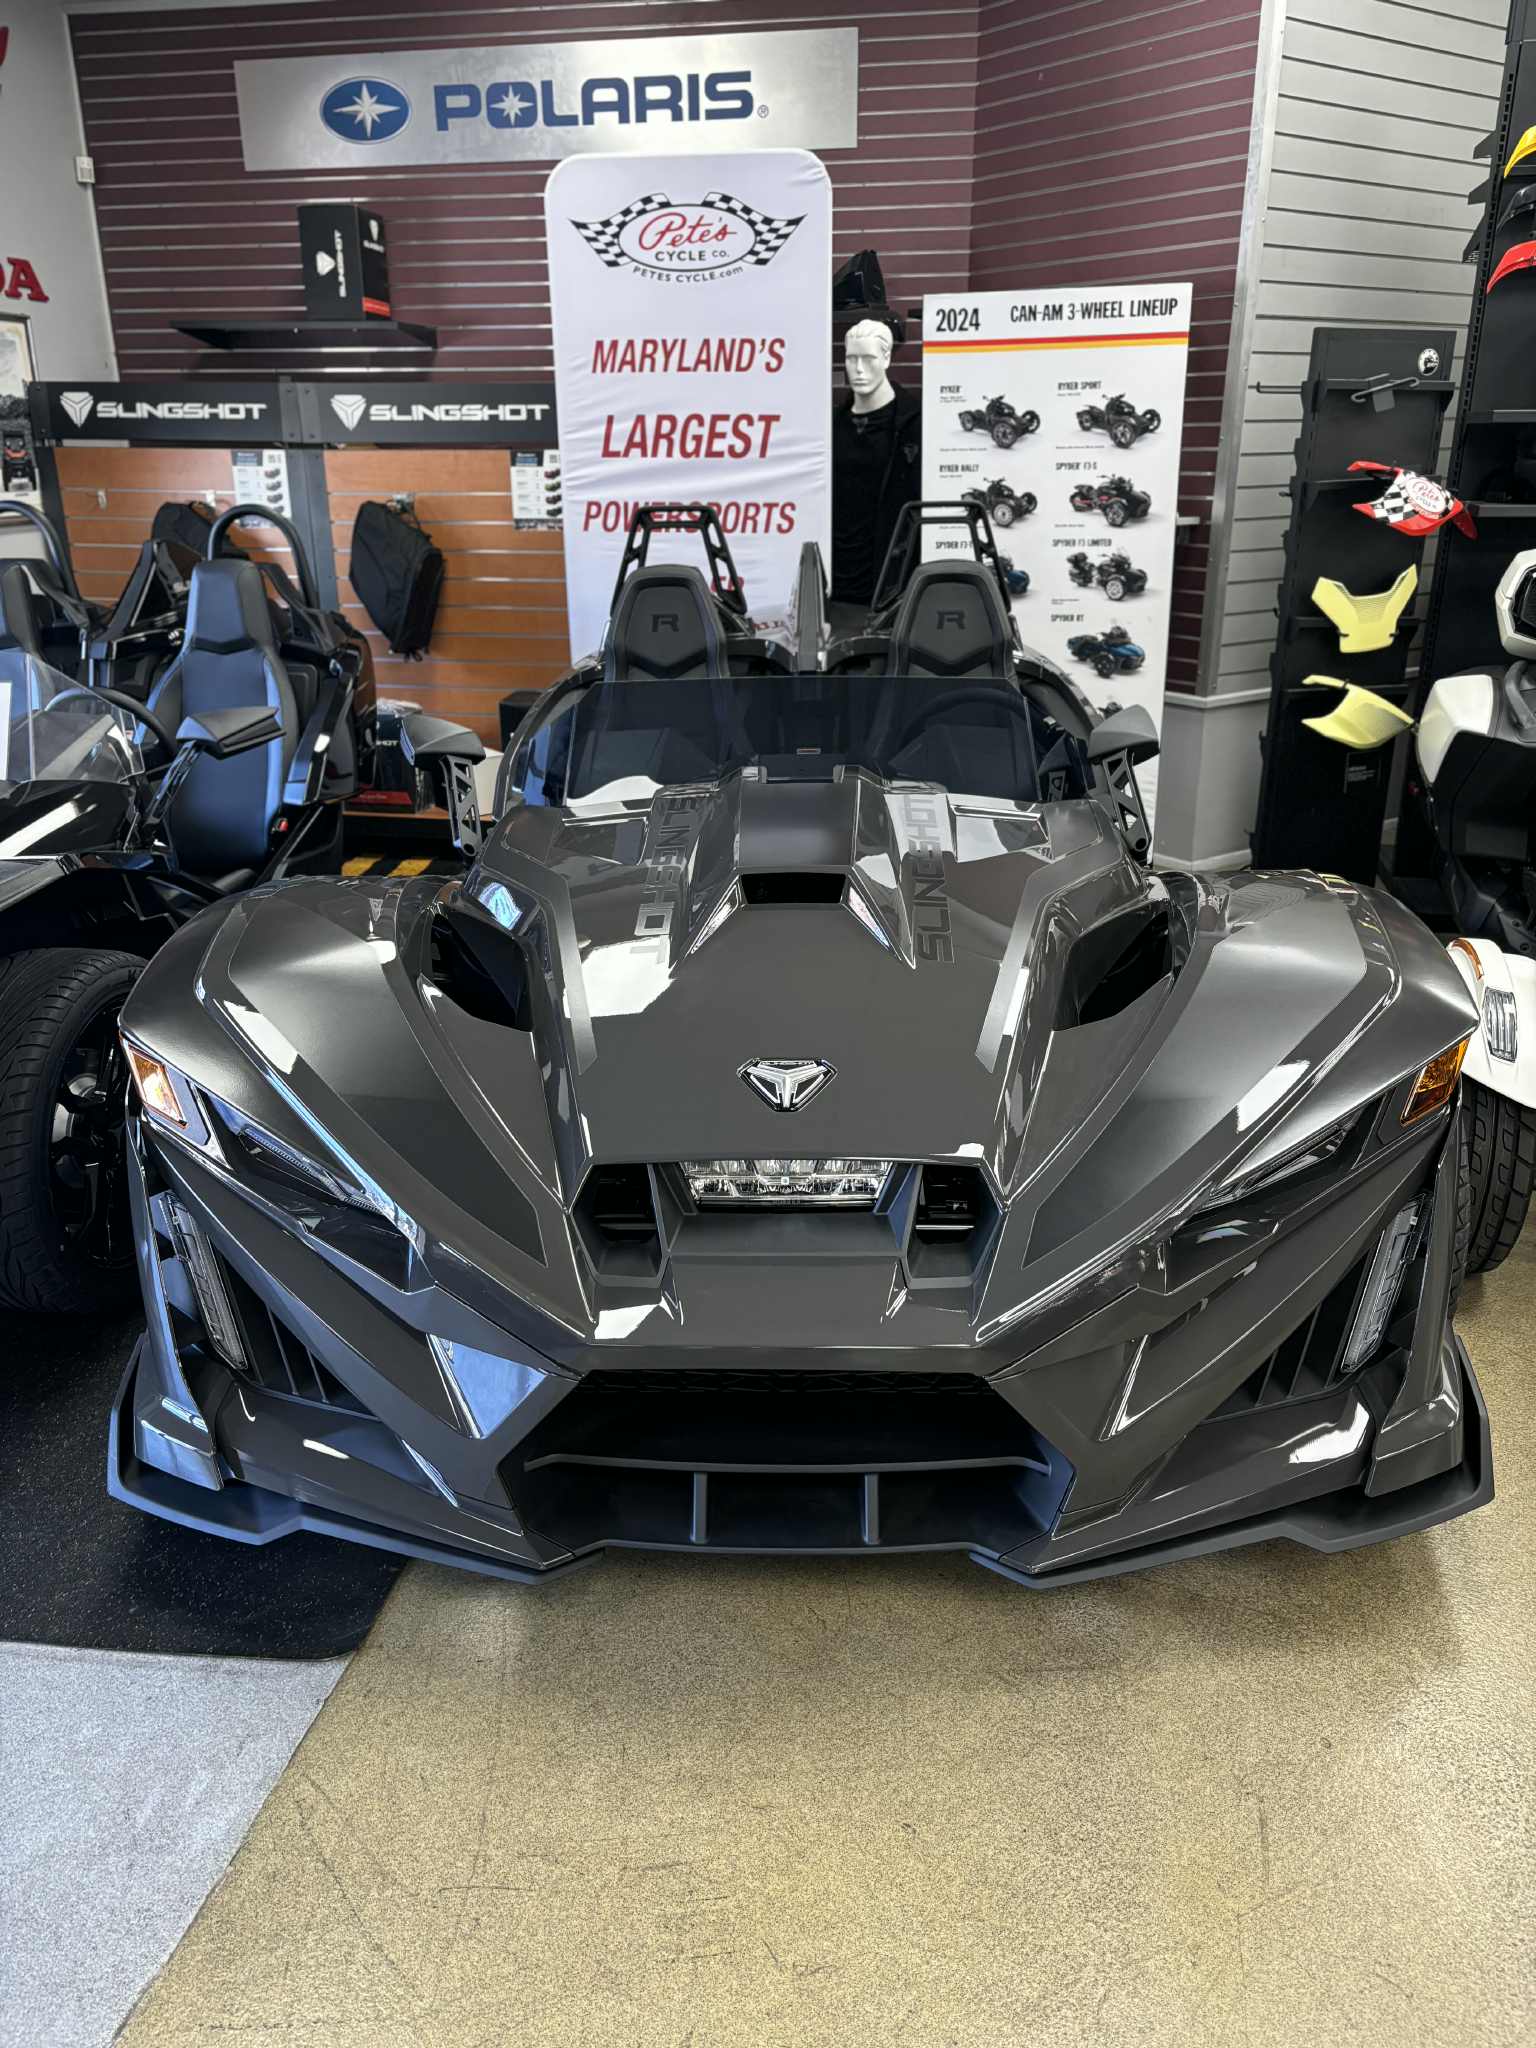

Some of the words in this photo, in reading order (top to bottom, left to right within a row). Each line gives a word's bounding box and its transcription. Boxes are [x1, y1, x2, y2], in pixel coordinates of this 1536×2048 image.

[638, 212, 737, 251] Pete's
[655, 251, 706, 262] CYCLE
[936, 308, 981, 332] 2024
[1010, 303, 1063, 322] CAN-AM
[1067, 301, 1125, 320] 3-WHEEL
[1130, 298, 1178, 317] LINEUP
[592, 338, 786, 373] MARYLAND'S
[1080, 381, 1102, 389] SPORT
[96, 401, 268, 420] SLINGSHOT
[369, 404, 551, 421] SLINGSHOT
[601, 414, 780, 459] LARGEST
[651, 614, 680, 633] R
[936, 610, 966, 630] R
